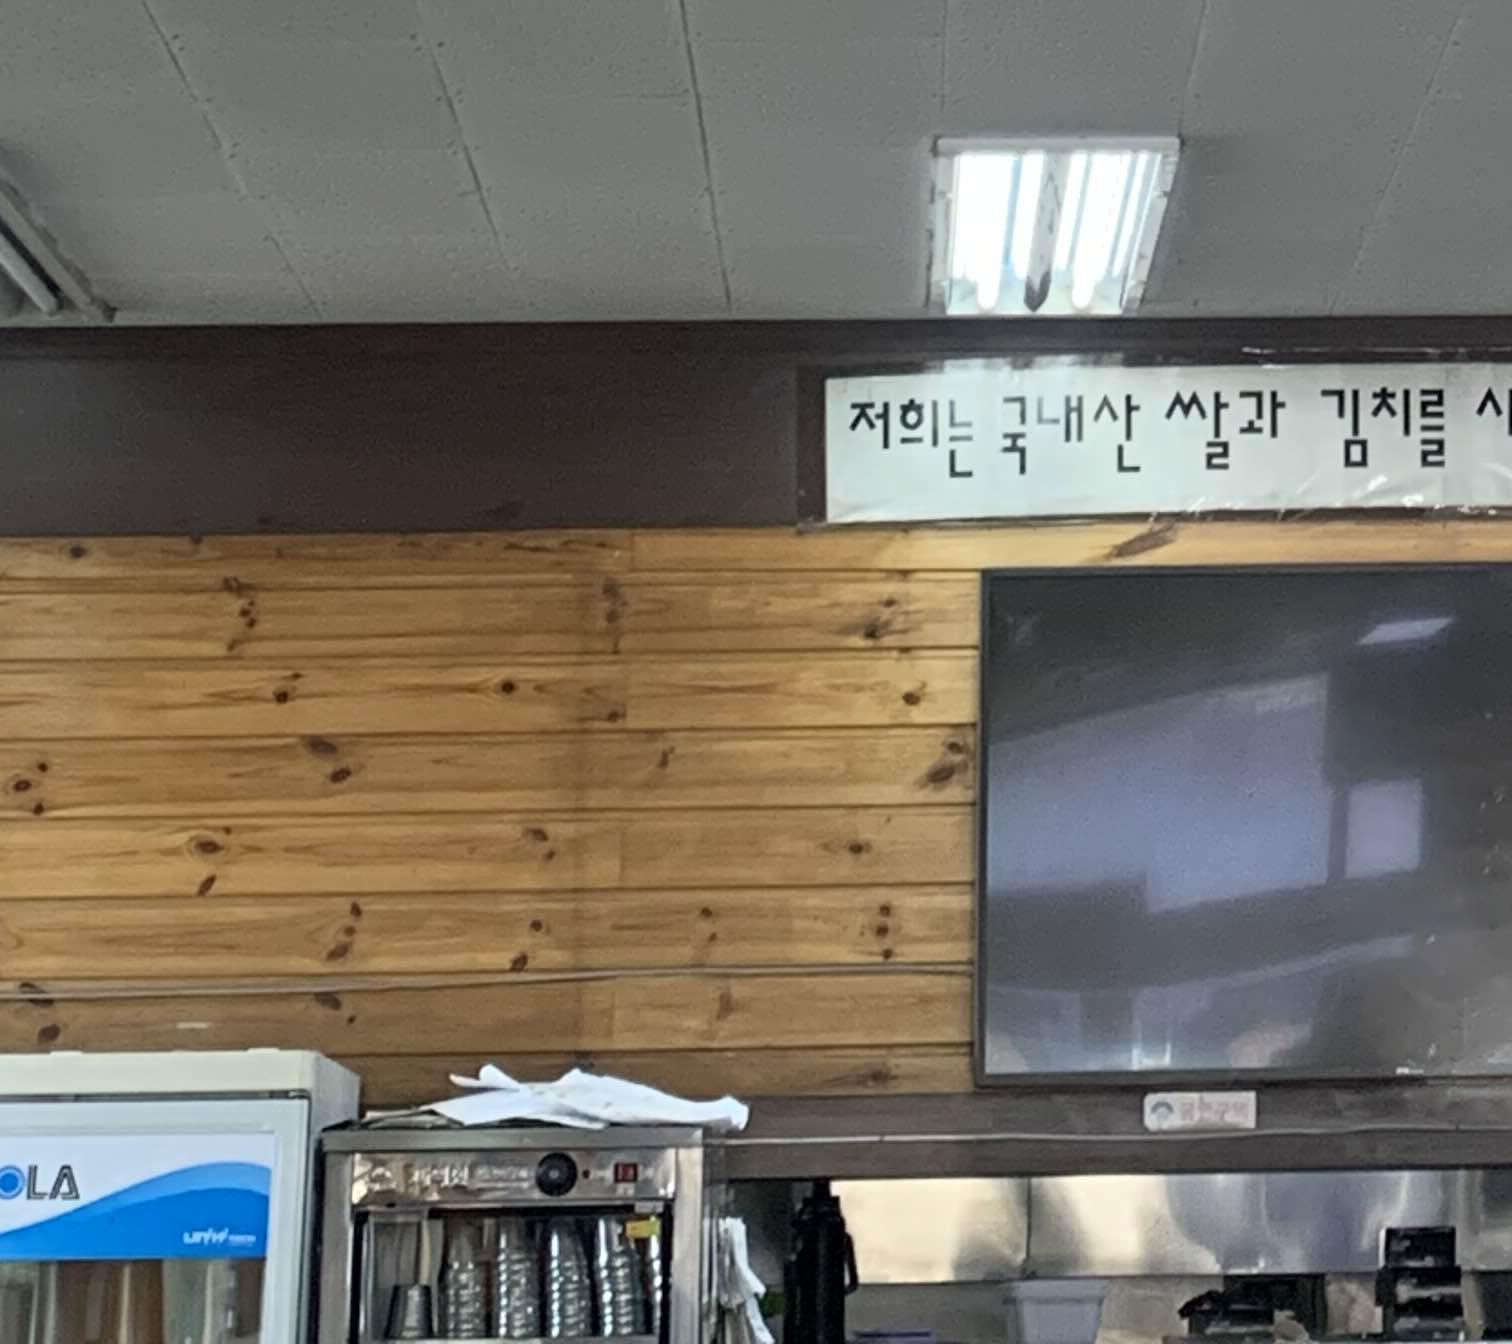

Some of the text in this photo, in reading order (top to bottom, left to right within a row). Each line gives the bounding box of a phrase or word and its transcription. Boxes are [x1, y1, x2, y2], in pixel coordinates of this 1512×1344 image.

[849, 397, 973, 479] 저희는
[1001, 393, 1141, 476] 국내산
[1165, 389, 1287, 471] 쌀과
[1320, 386, 1446, 468] 김치를
